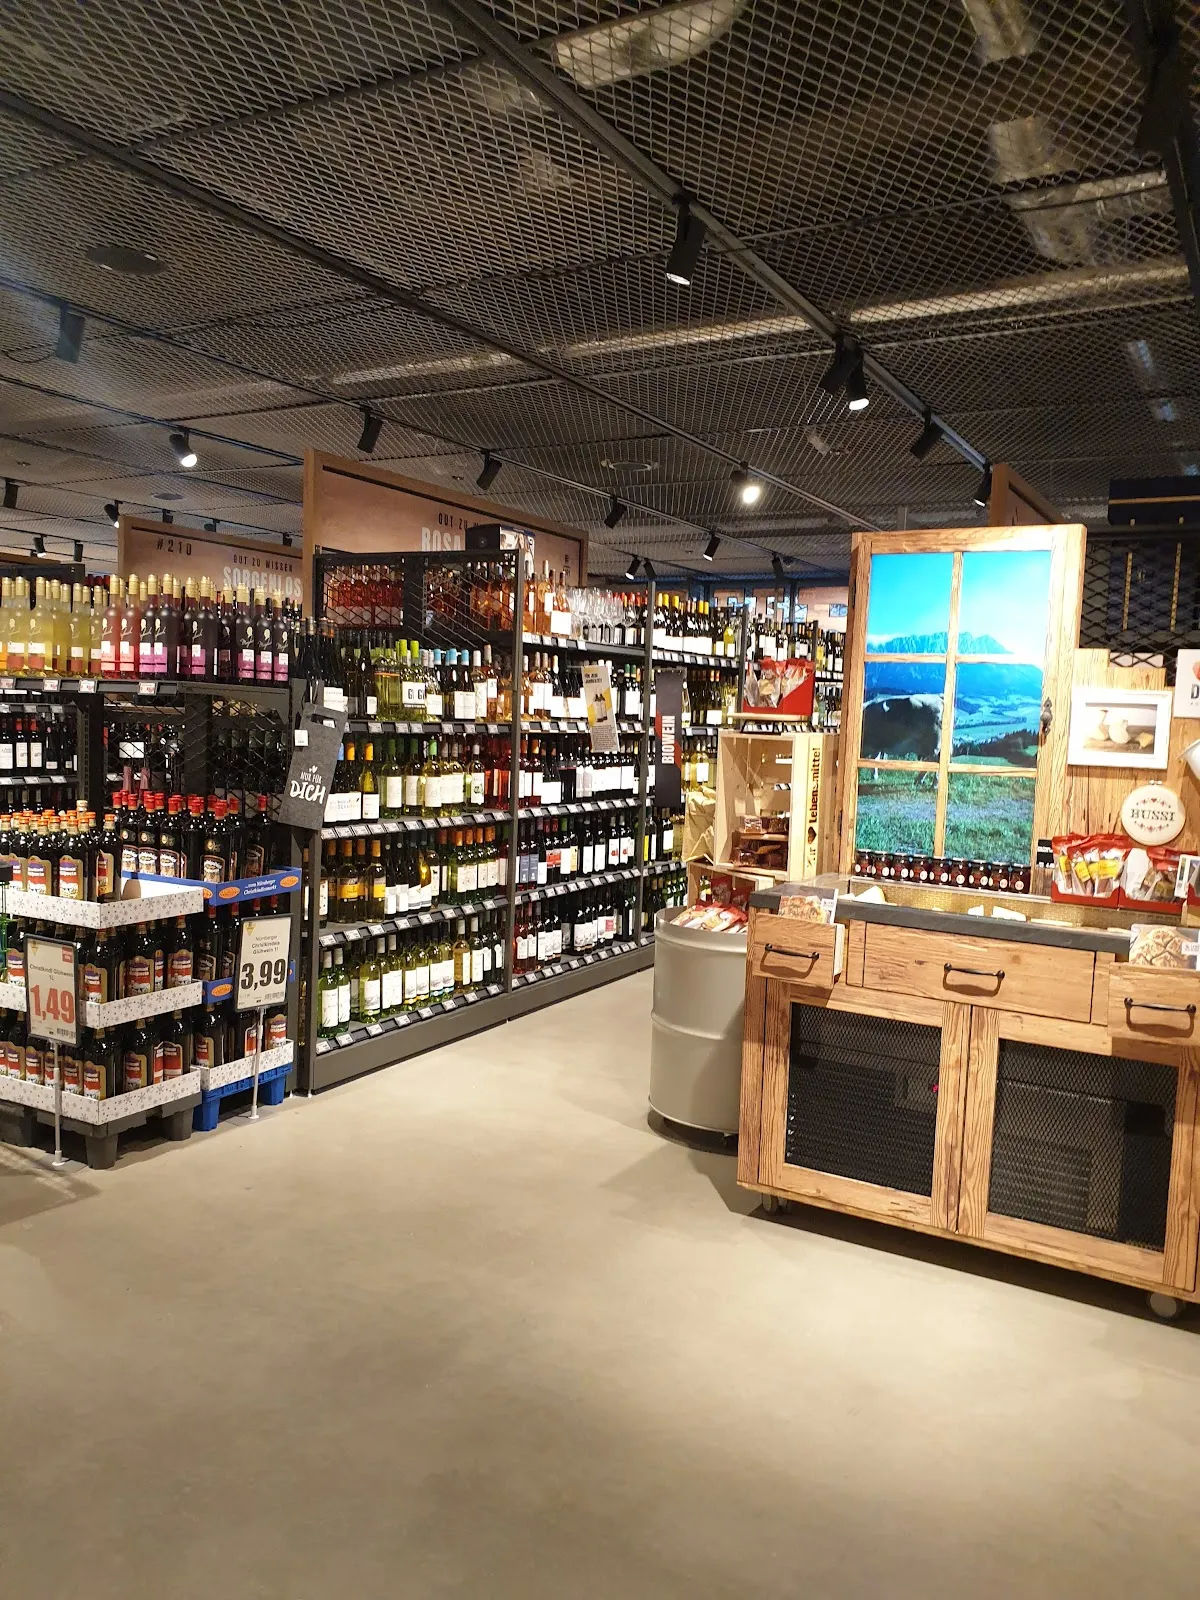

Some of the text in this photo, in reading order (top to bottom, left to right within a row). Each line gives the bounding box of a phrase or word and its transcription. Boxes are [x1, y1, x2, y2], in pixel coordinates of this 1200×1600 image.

[438, 512, 453, 528] GUT
[459, 518, 468, 530] ZU
[157, 538, 192, 556] #210
[233, 554, 293, 572] GUT ZU WISSEN
[662, 715, 676, 764] BIOWEIN
[300, 771, 312, 782] NUR
[808, 748, 821, 823] Lebensmittel
[289, 780, 327, 805] DICH
[240, 958, 286, 991] 3,99
[30, 984, 75, 1024] 1,49
